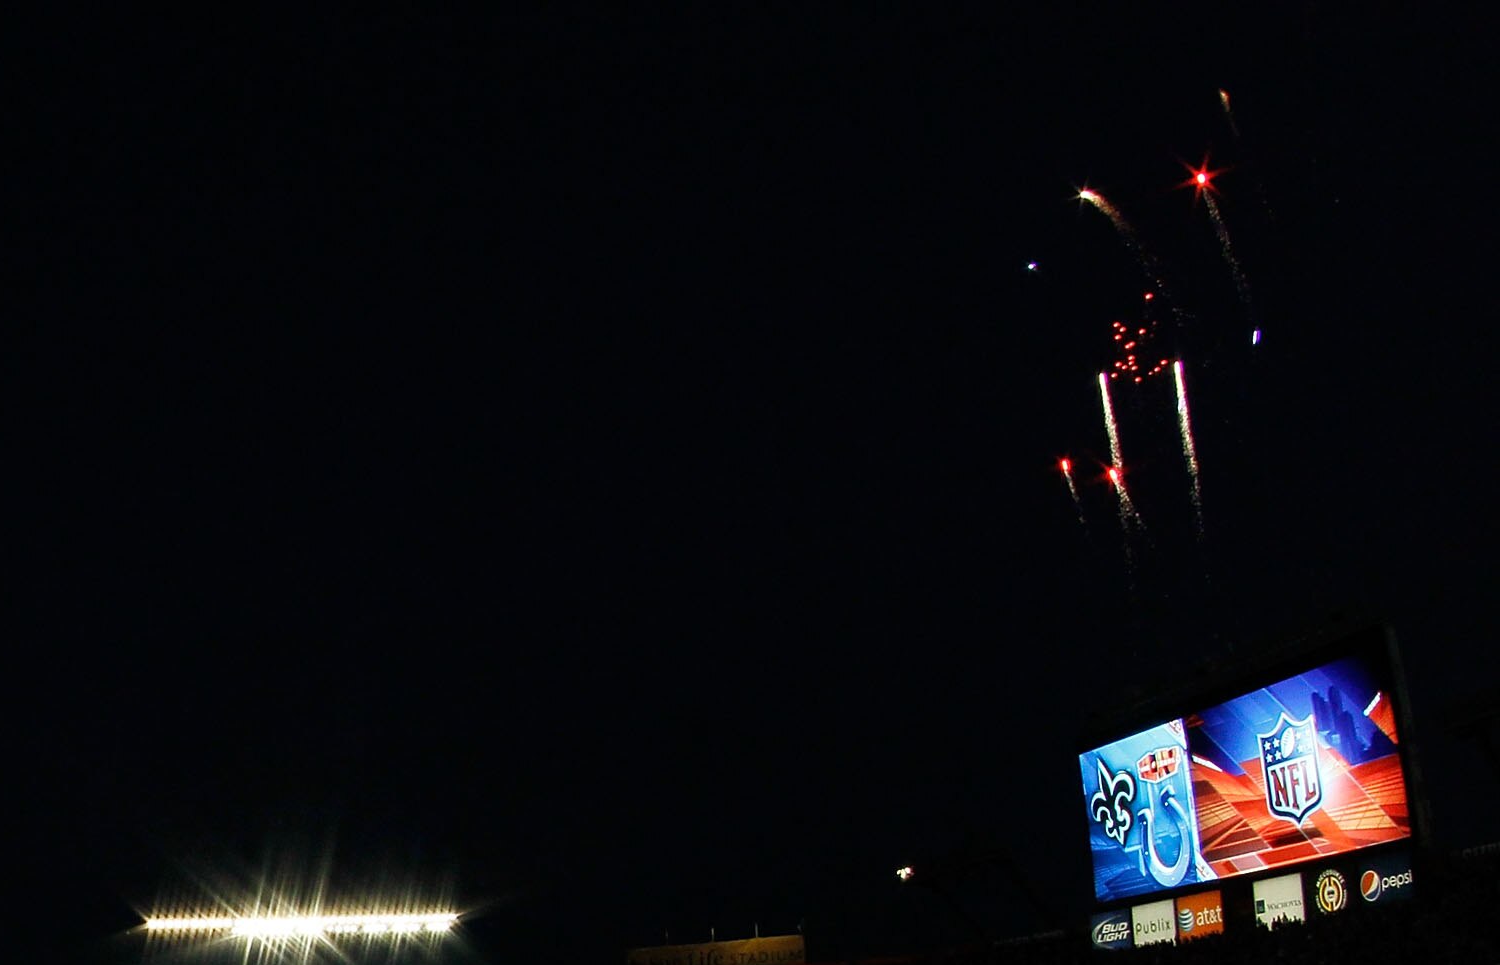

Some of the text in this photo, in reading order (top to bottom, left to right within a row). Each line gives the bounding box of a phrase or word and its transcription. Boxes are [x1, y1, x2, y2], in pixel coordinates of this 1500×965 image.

[1270, 757, 1317, 811] NFL
[1381, 869, 1413, 891] pepsi
[1196, 905, 1223, 926] at&t
[1102, 921, 1129, 934] BUD
[1135, 919, 1171, 935] Publix
[1097, 930, 1130, 943] LIGHT
